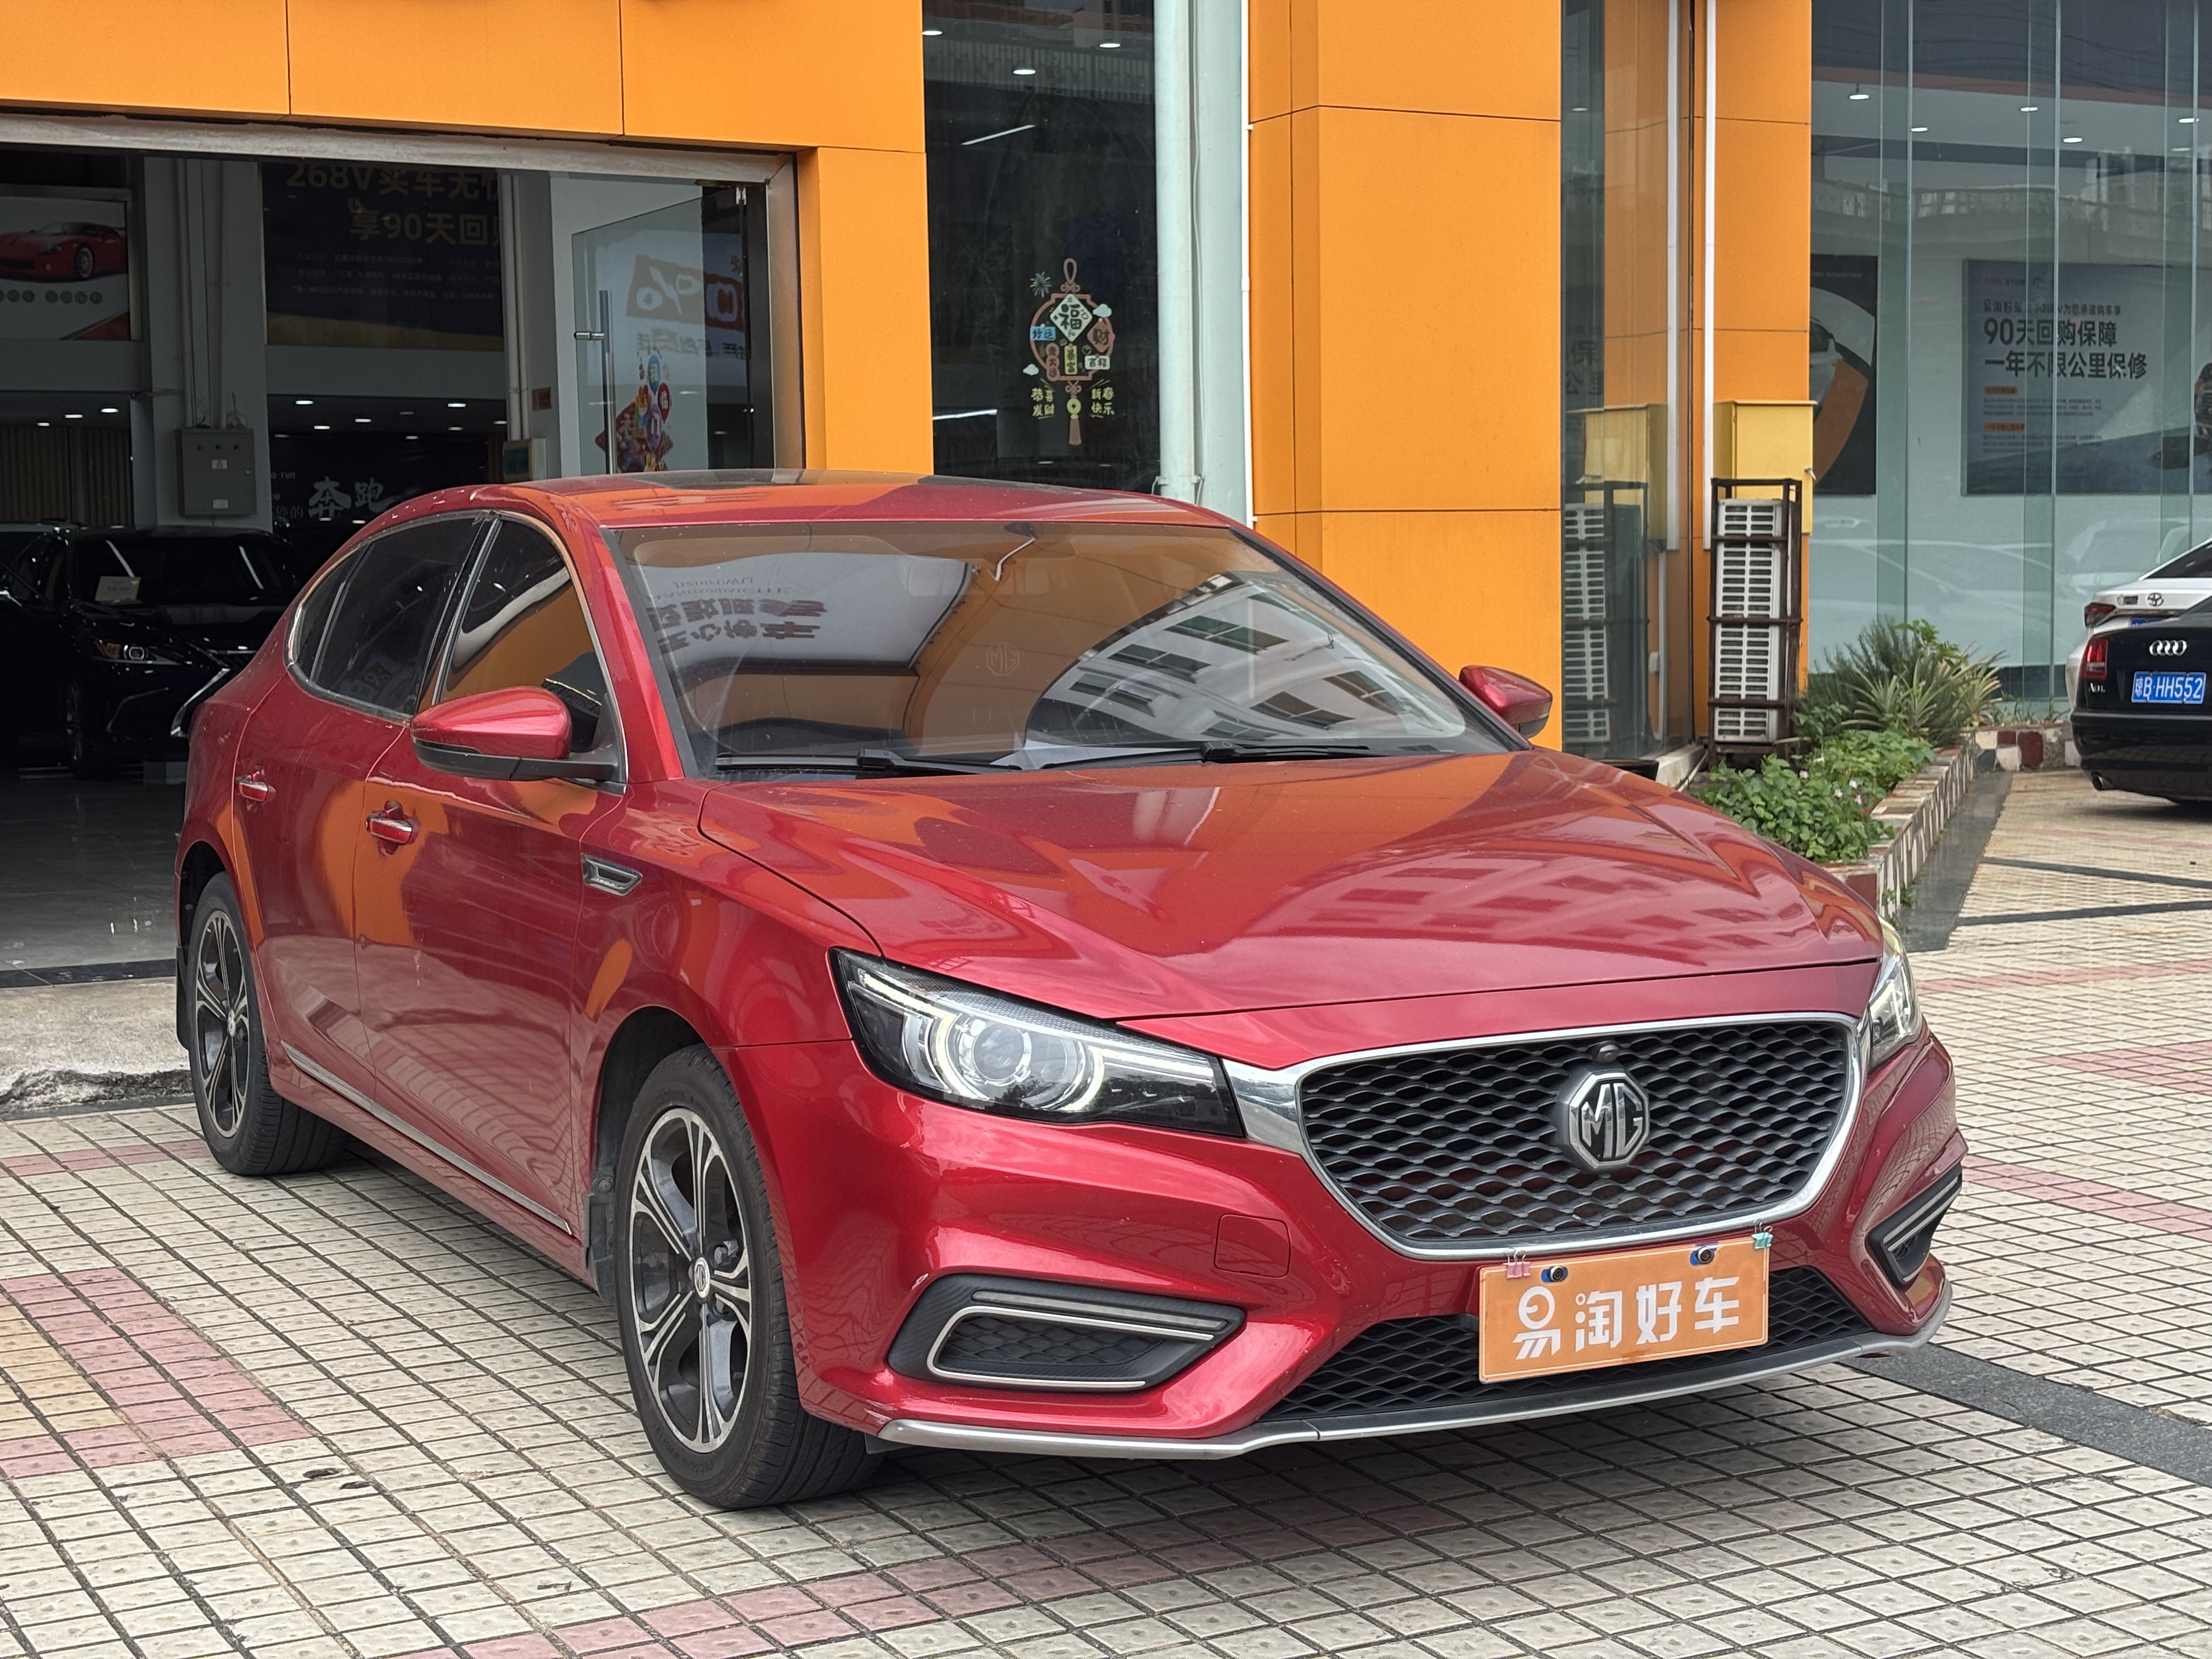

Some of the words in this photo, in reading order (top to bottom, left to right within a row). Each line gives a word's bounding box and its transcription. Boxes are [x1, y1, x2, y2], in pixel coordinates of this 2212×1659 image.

[350, 207, 499, 247] 享90天回
[1058, 303, 1083, 330] 福
[1984, 317, 2117, 347] 90天回购保障
[1984, 350, 2147, 380] 一年不限公里保修
[1576, 1081, 1644, 1162] MG
[1511, 1276, 1740, 1361] 易淘好车
